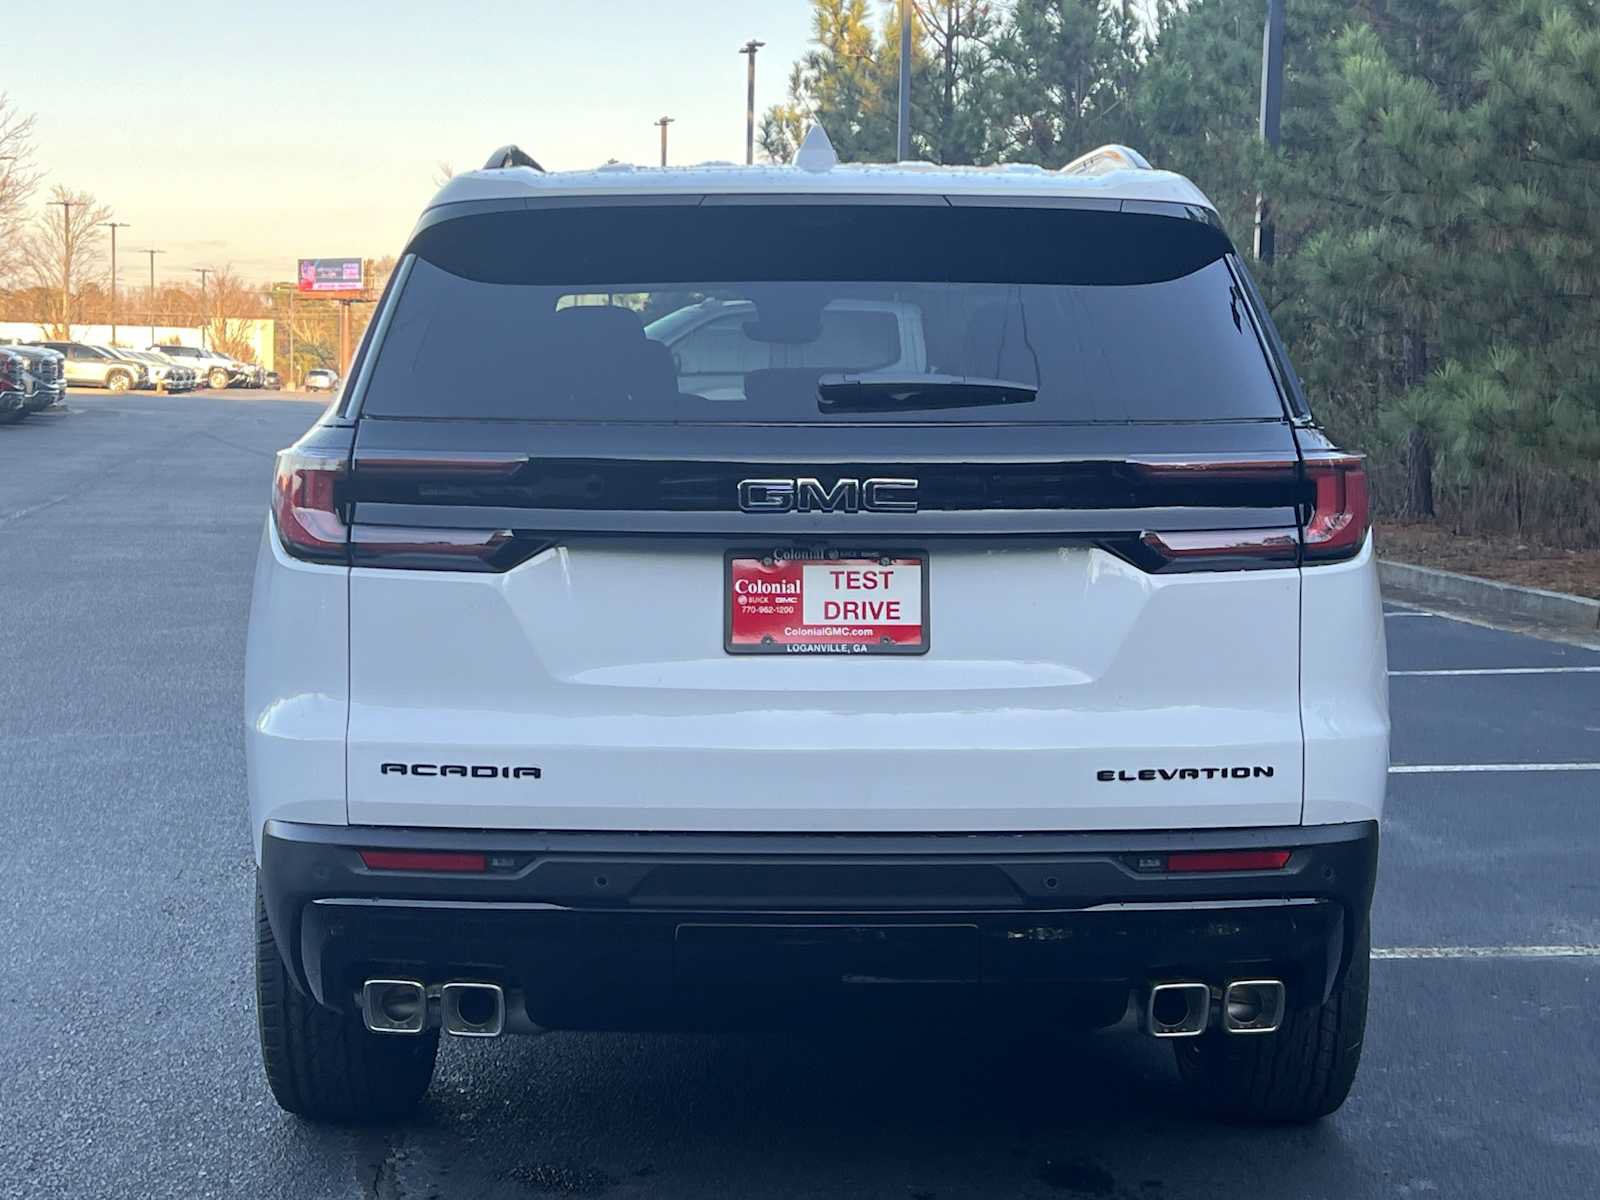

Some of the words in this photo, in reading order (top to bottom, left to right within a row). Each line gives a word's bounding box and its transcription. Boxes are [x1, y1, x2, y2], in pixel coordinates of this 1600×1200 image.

[737, 478, 918, 513] GMC
[735, 579, 800, 594] Colonial
[830, 571, 894, 590] TEST
[775, 596, 798, 604] GMC
[742, 606, 794, 614] 770-962-1200
[824, 601, 901, 620] DRIVE
[784, 627, 873, 636] ColonialGMC.com
[786, 643, 851, 653] LOGANVILLE,
[853, 643, 868, 653] GA
[381, 763, 541, 779] ACADIA
[1097, 766, 1275, 782] ELEVATION
